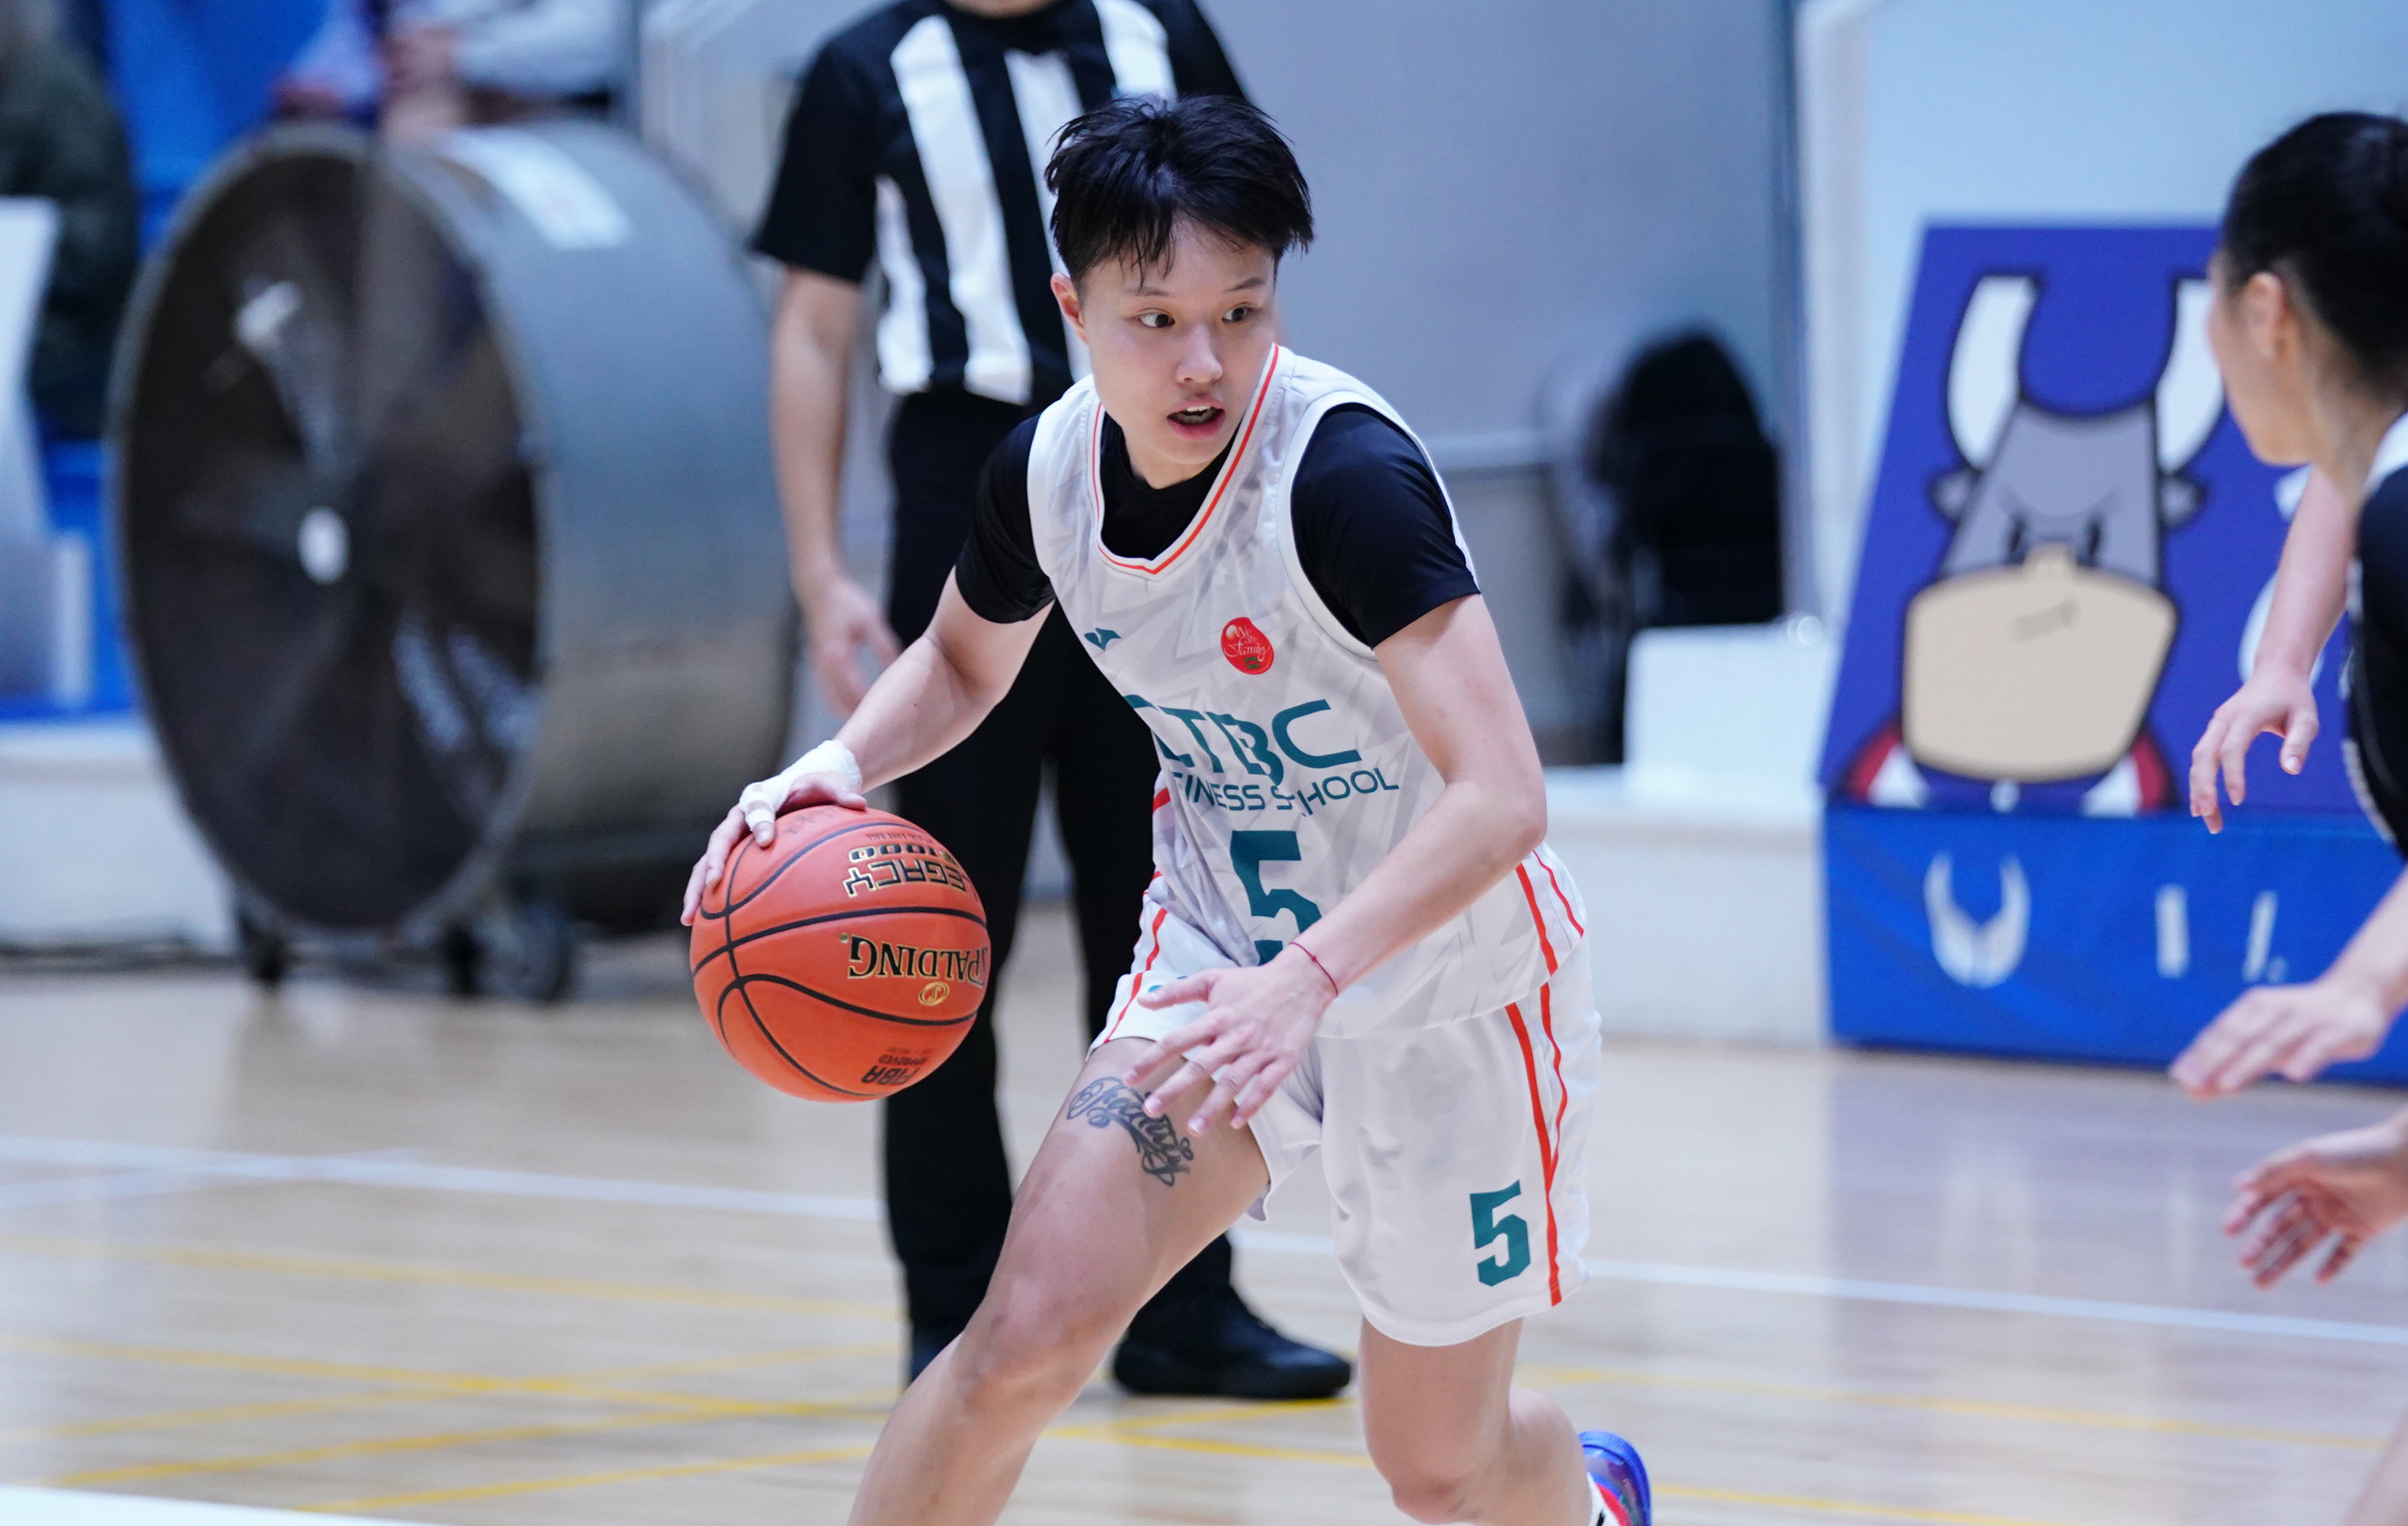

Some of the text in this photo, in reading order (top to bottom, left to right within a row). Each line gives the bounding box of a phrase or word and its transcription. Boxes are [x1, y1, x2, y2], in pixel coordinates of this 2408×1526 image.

[1173, 767, 1400, 817] INESS SHOOL
[1230, 829, 1322, 966] 5
[848, 934, 988, 990] SPALDING
[861, 1065, 920, 1085] FIBA
[1469, 1179, 1530, 1287] 5
